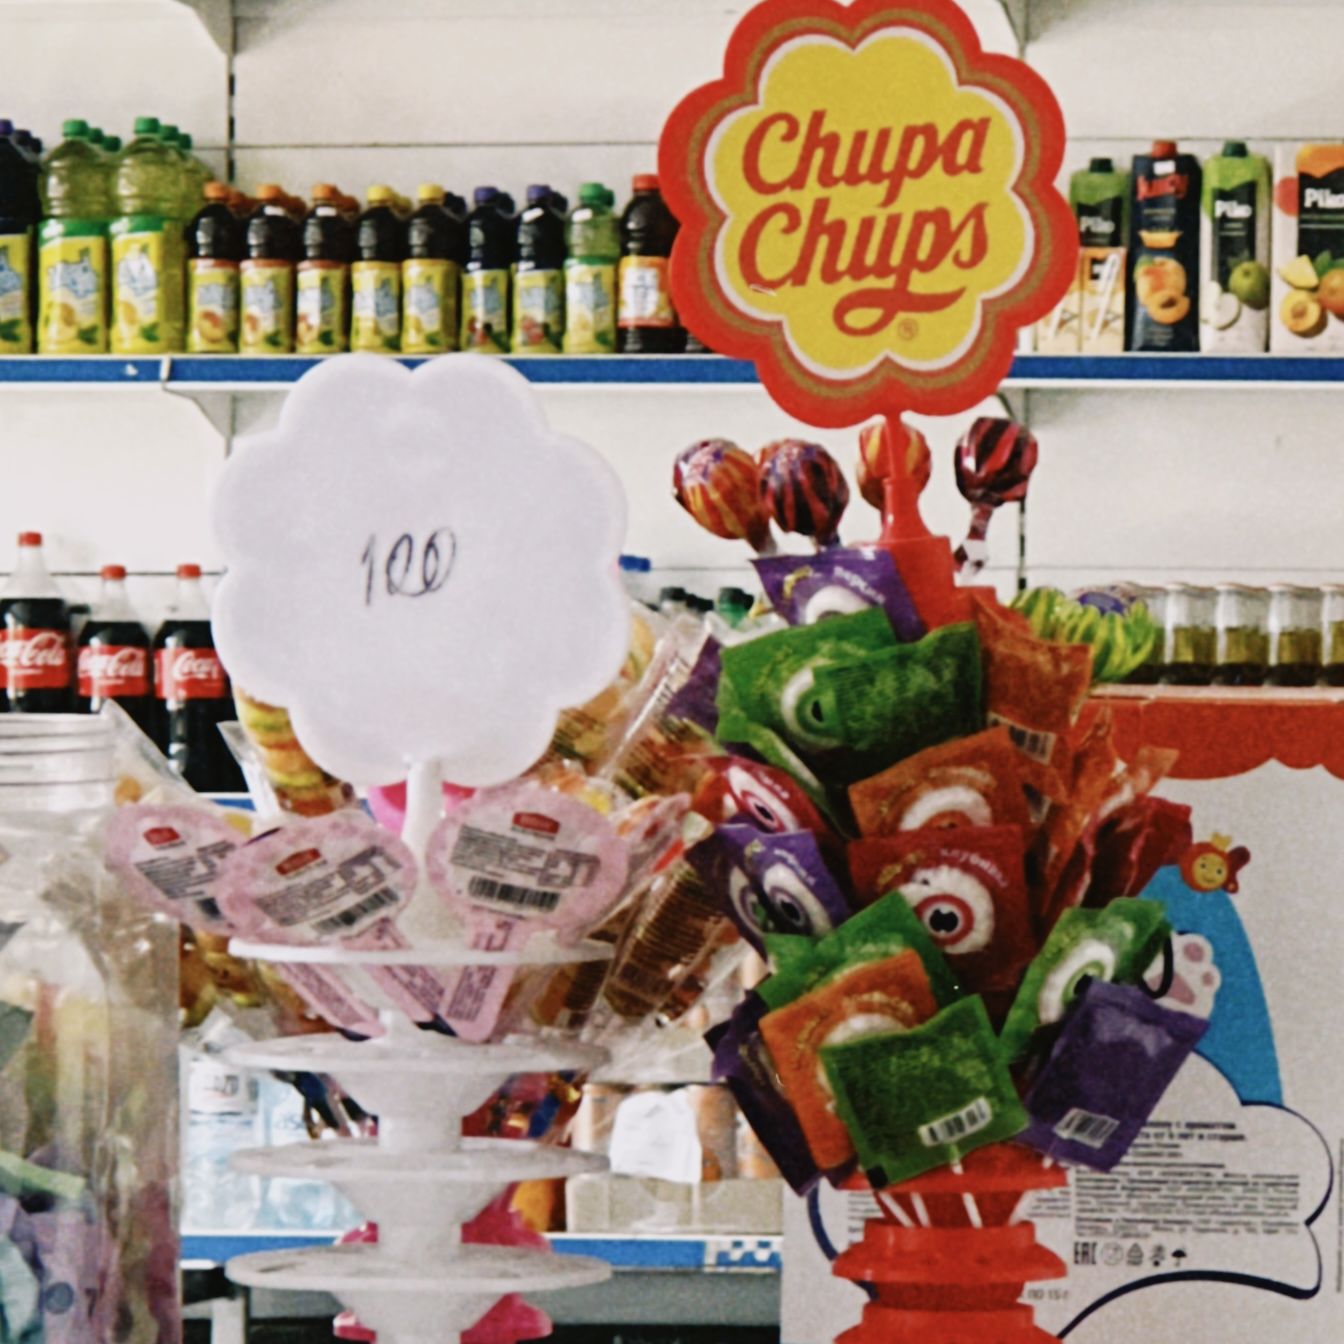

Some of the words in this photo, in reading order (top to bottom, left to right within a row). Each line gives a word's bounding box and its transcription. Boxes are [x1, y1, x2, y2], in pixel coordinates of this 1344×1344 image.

[742, 109, 991, 208] Chupa
[738, 197, 990, 337] Chups
[361, 527, 457, 606] 100
